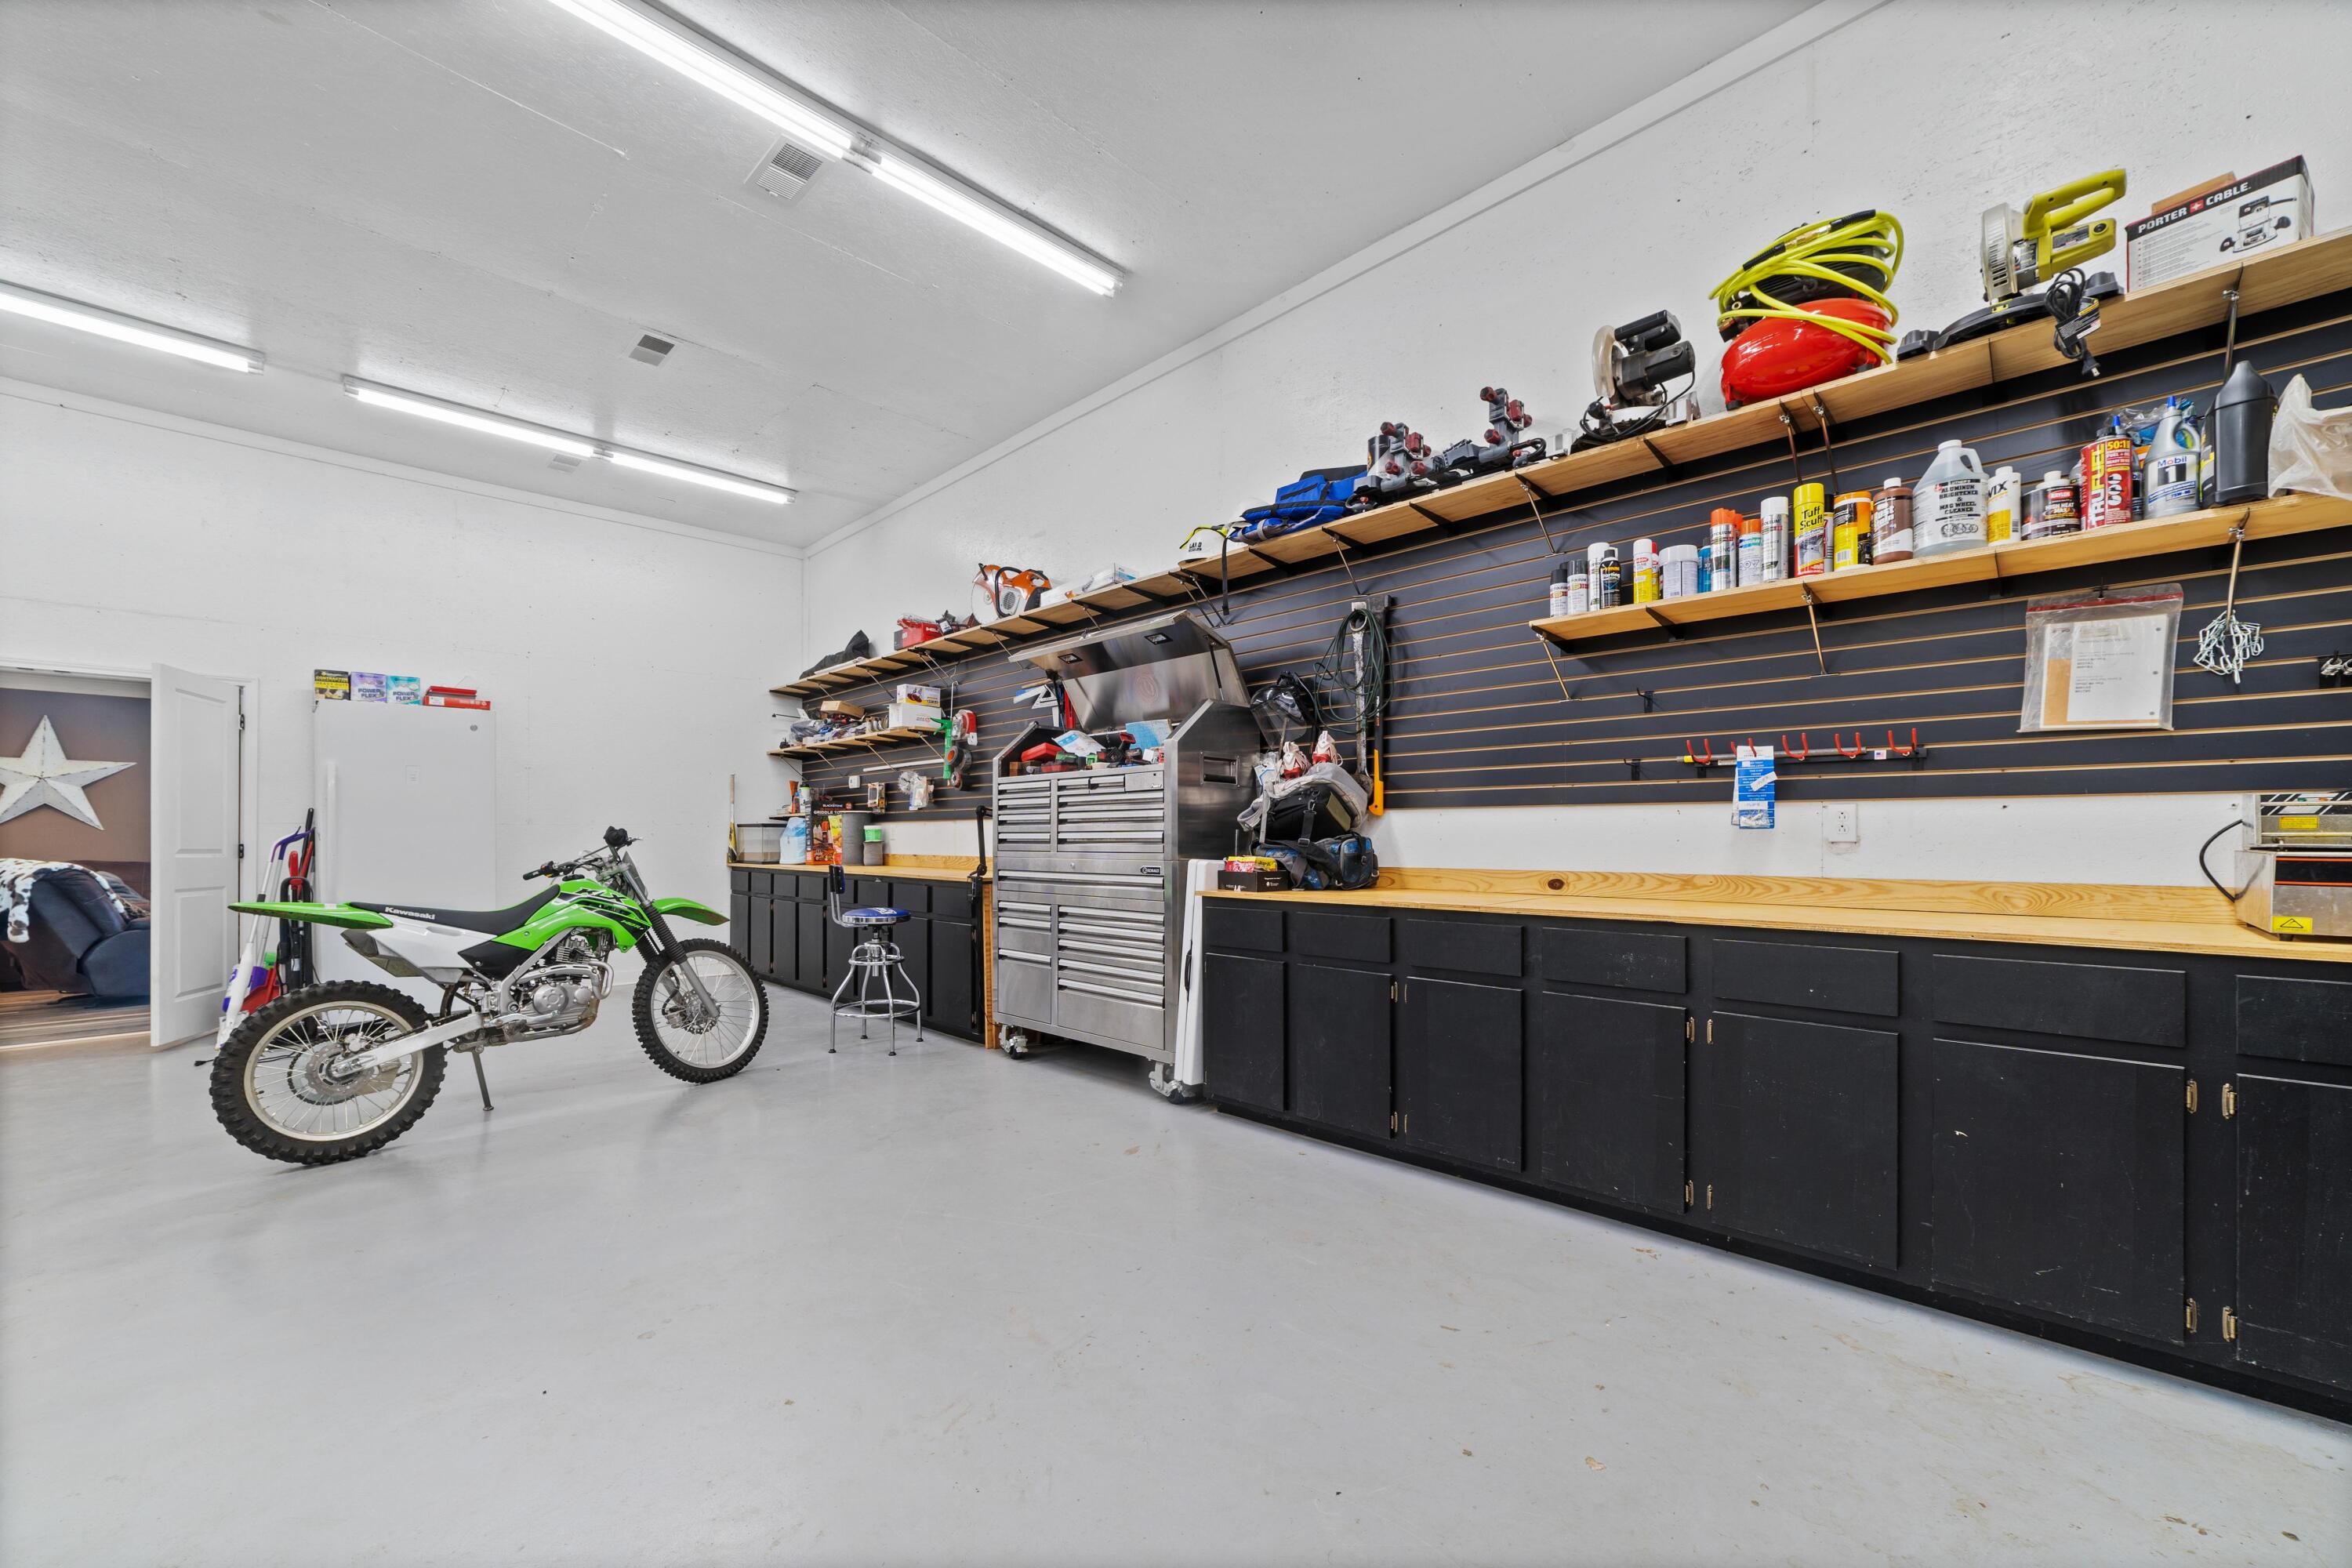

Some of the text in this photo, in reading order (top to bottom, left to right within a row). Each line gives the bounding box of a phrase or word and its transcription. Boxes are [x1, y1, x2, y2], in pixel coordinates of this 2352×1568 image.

[2138, 182, 2250, 234] PORTER CABLE
[2107, 440, 2126, 450] 50:1
[2158, 456, 2187, 468] Mobil
[1941, 485, 1975, 493] ALUMINUM
[1802, 506, 1820, 519] Tuff
[384, 906, 436, 920] Kawasaki
